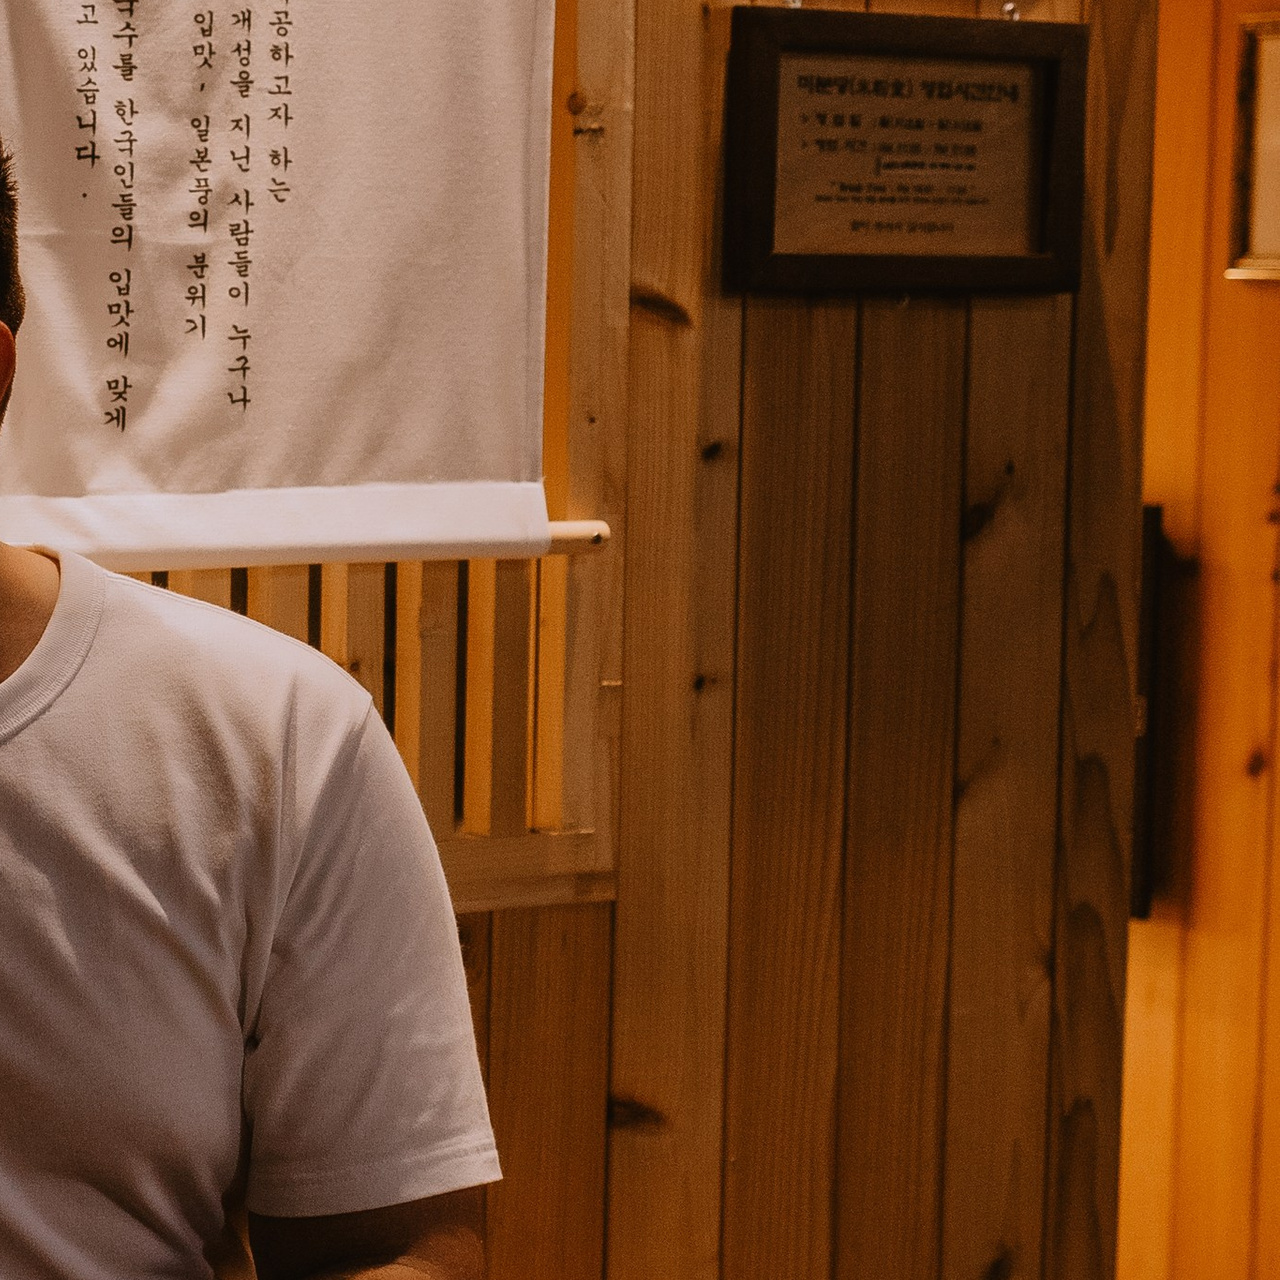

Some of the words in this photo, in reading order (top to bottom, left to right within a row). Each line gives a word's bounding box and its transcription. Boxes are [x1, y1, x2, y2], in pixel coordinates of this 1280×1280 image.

[228, 6, 256, 100] 개성을
[108, 95, 141, 254] 한국인들의
[186, 112, 214, 235] 일본풍의
[228, 111, 252, 174] 지닌
[266, 144, 294, 205] 하는
[225, 186, 256, 308] 사람들이
[105, 265, 136, 360] 입맛에
[183, 249, 211, 341] 분위기
[102, 372, 134, 434] 맞게
[225, 322, 253, 414] 누구나
